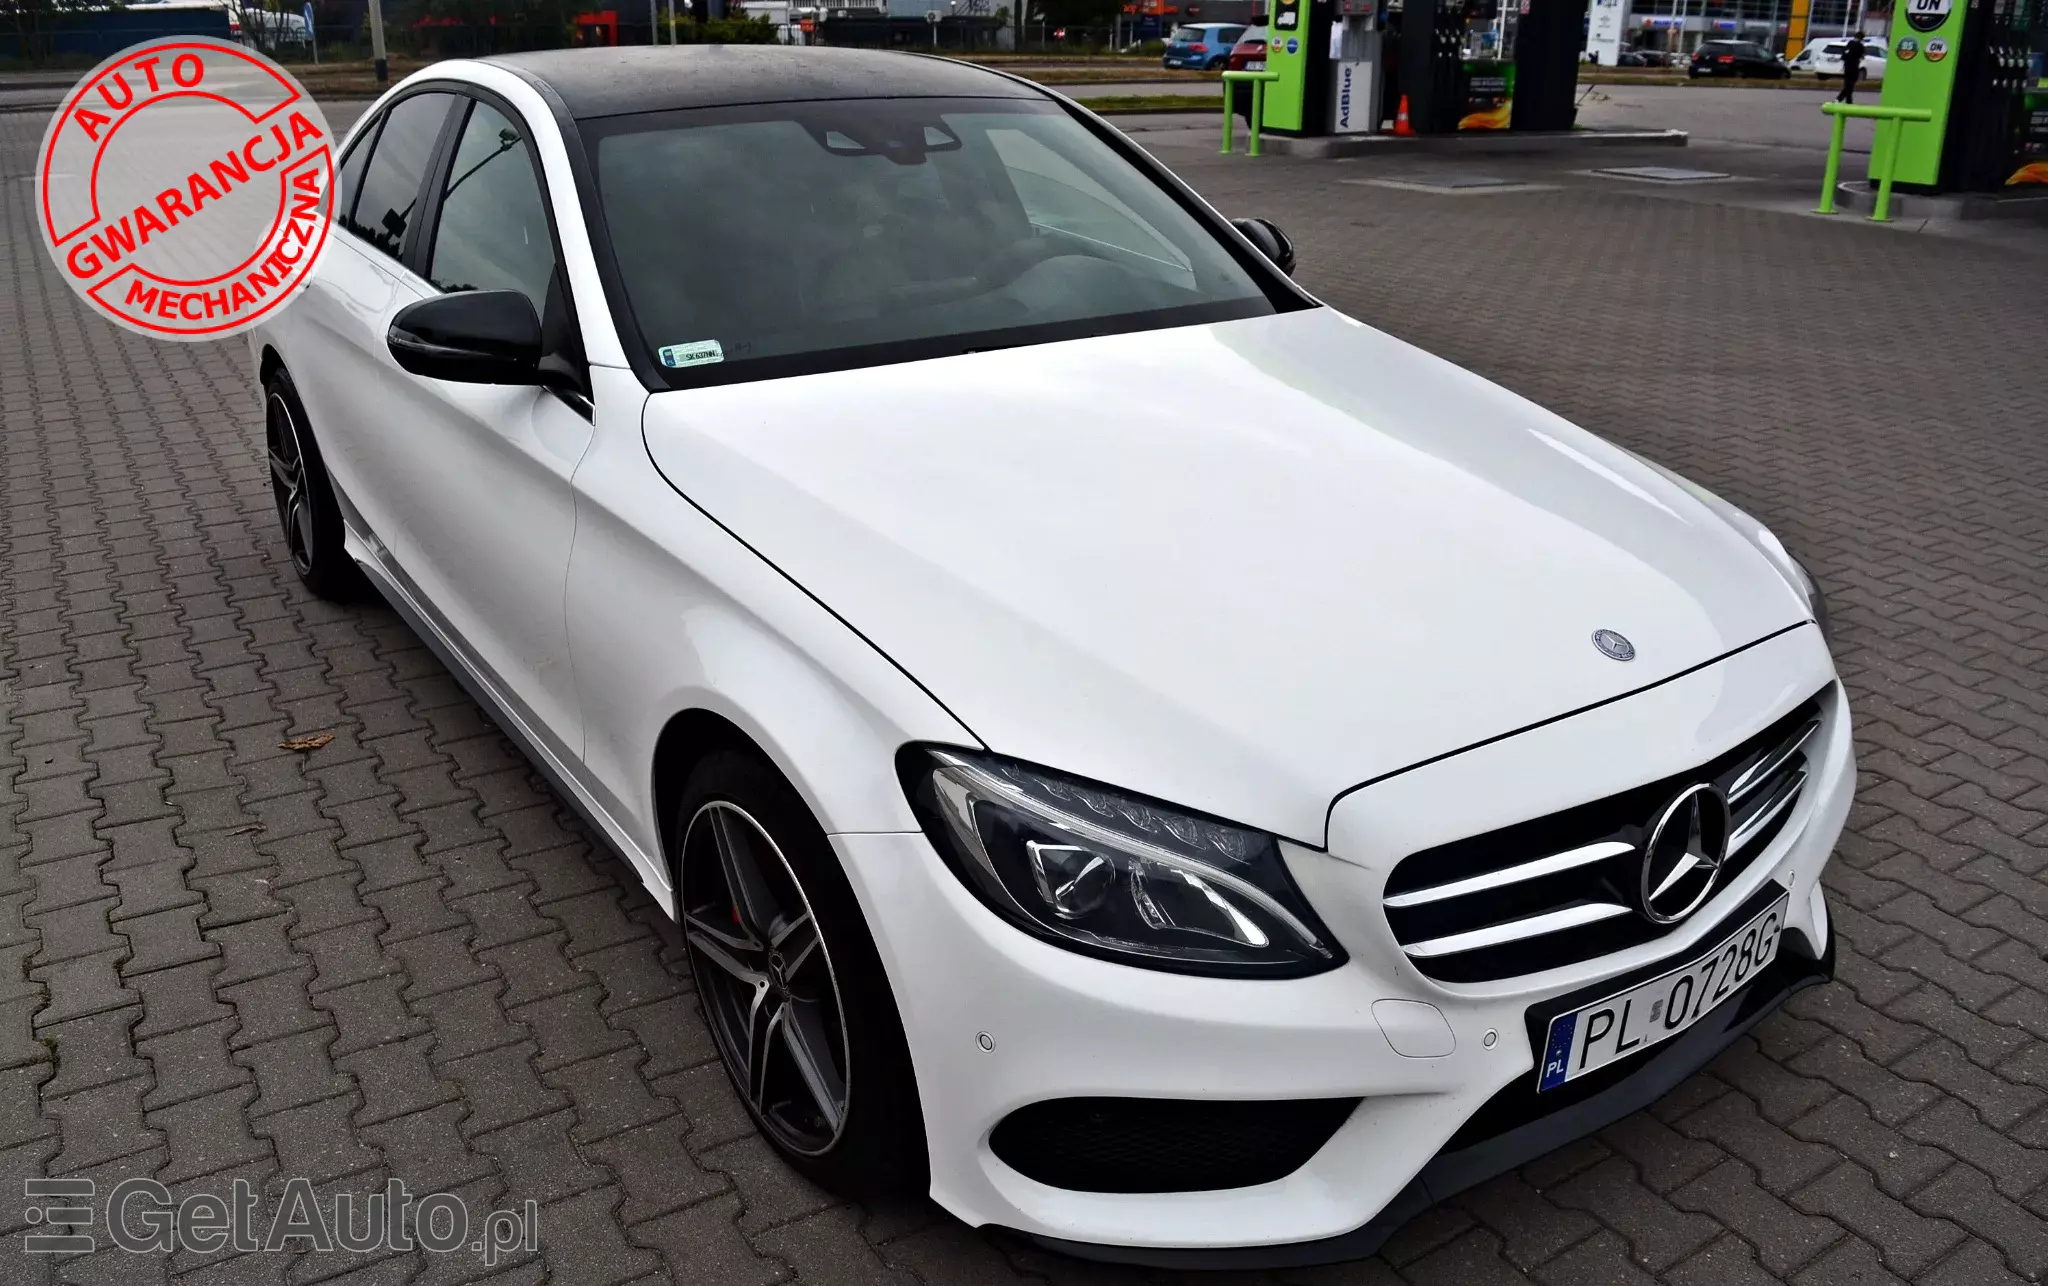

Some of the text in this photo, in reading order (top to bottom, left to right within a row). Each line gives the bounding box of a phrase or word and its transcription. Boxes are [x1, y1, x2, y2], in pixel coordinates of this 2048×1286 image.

[1340, 67, 1352, 128] AdBlue
[1578, 912, 1778, 1070] PL 0728G
[1546, 1061, 1564, 1078] PL
